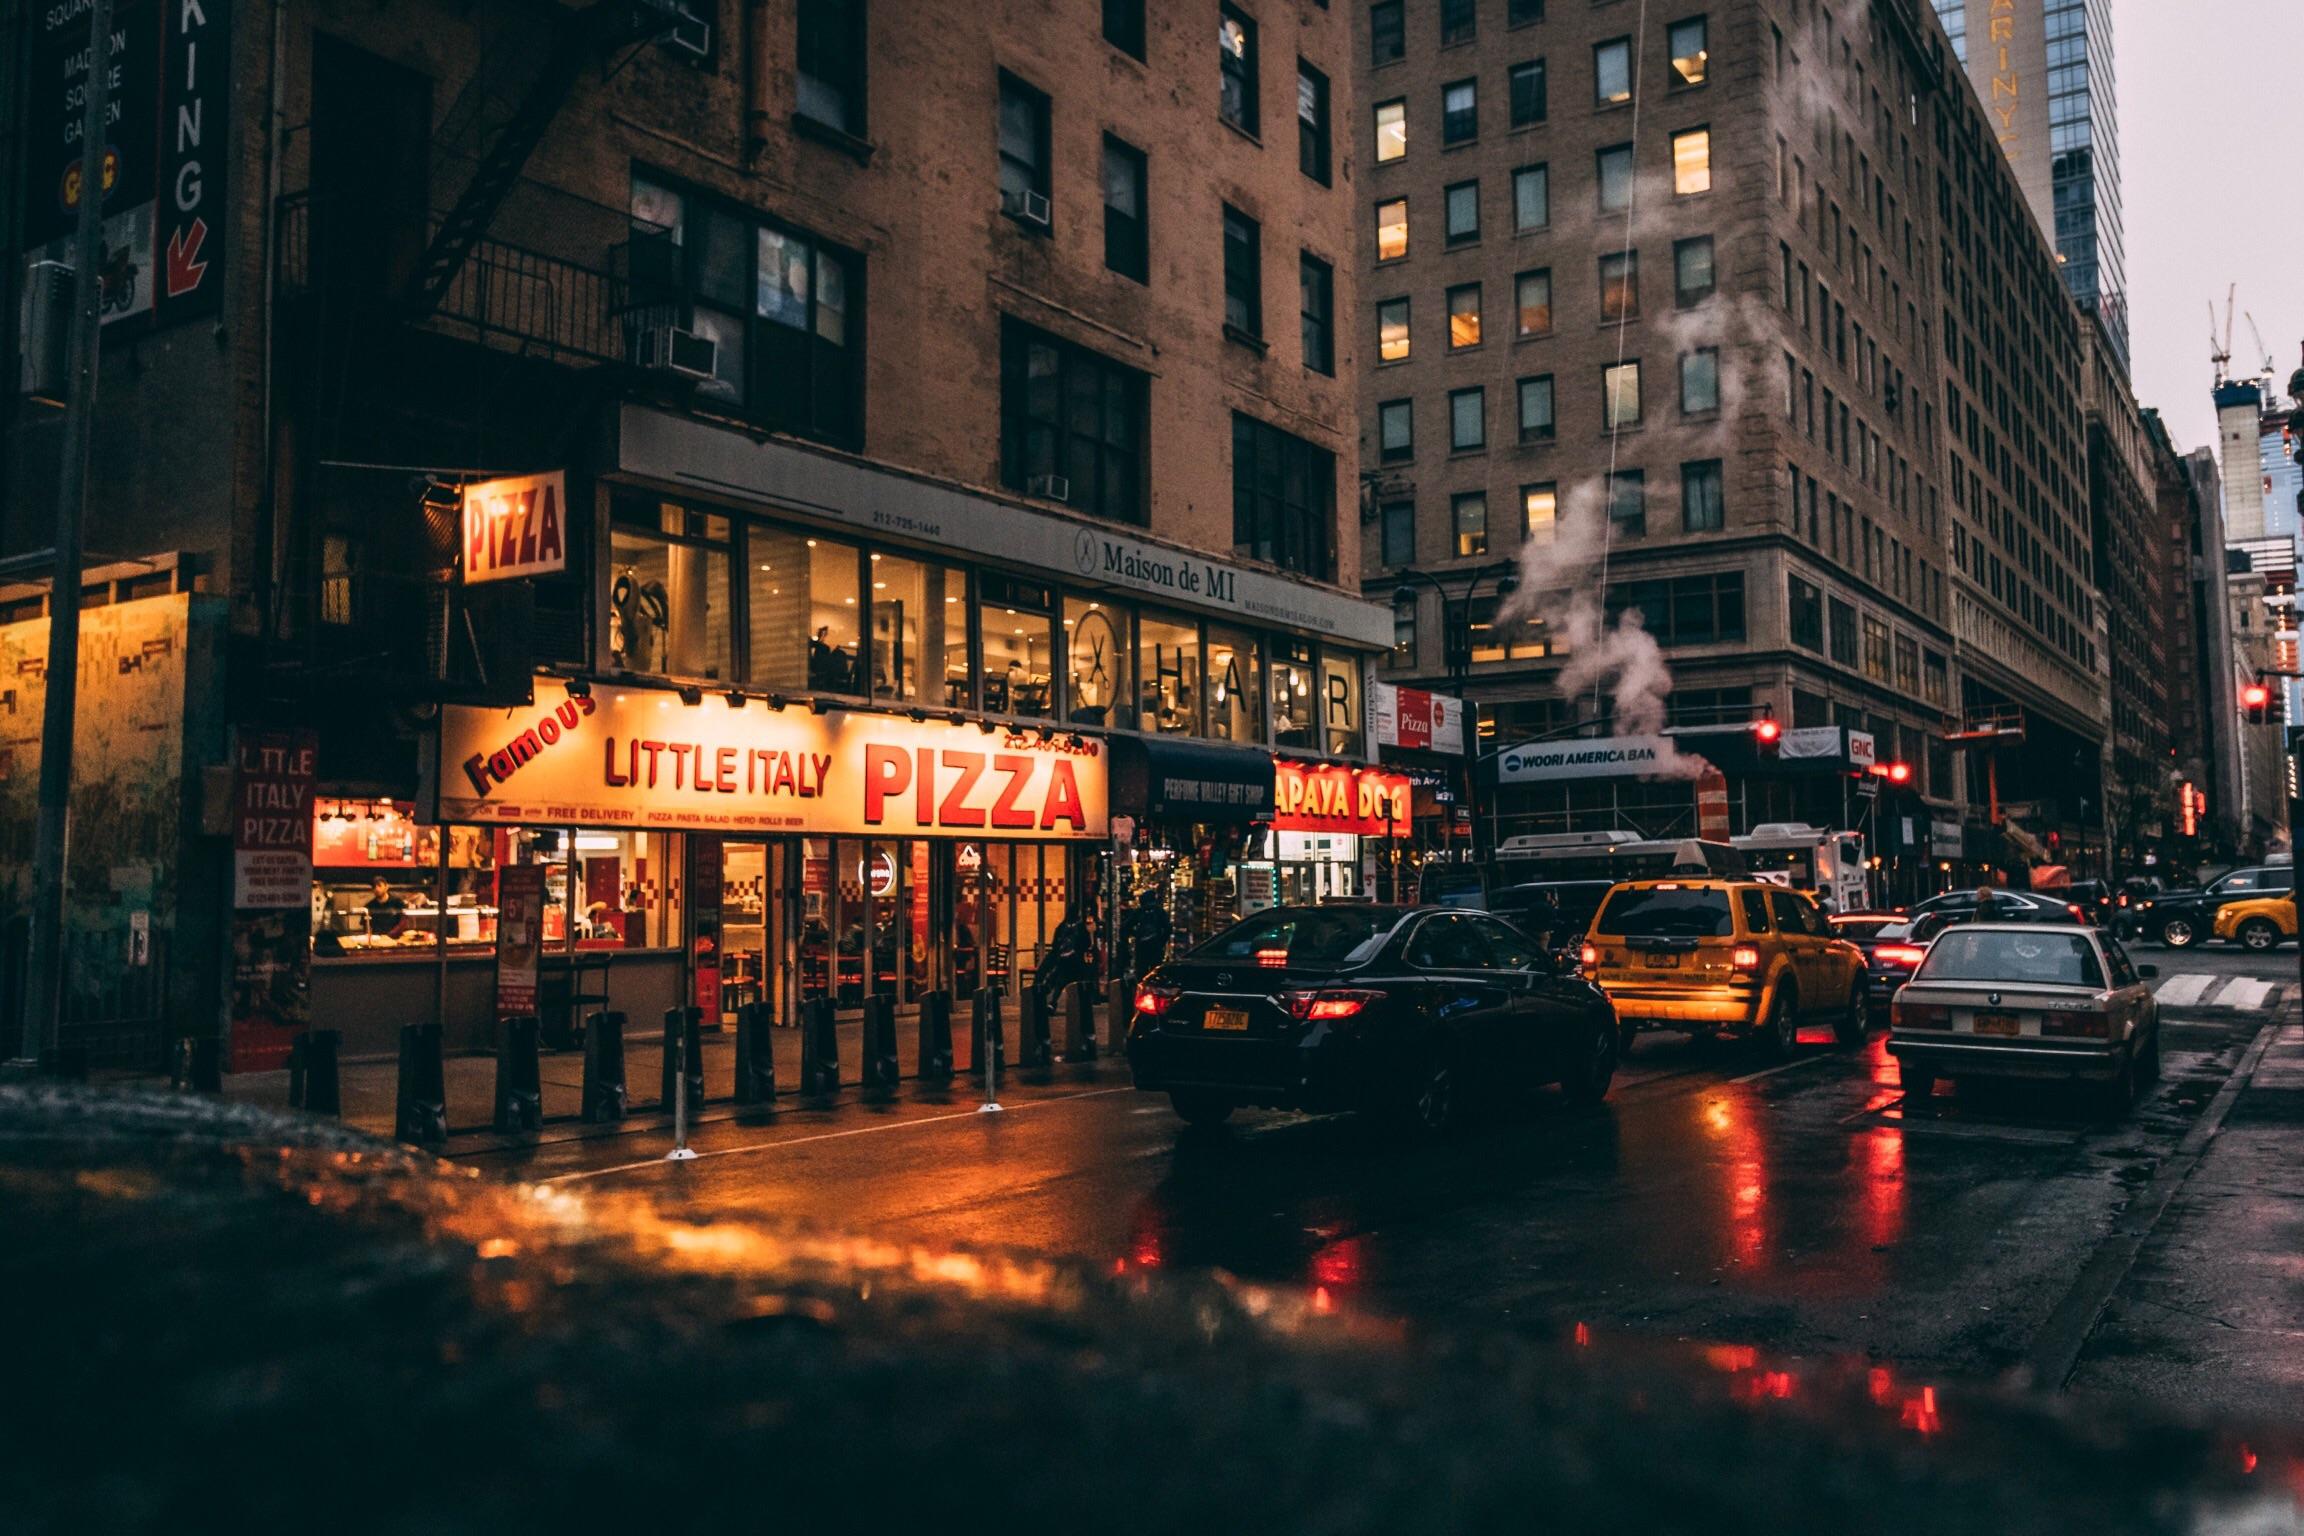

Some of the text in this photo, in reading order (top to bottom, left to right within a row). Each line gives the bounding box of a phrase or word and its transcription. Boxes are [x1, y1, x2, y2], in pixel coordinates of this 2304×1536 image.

[64, 28, 126, 80] MADON
[65, 64, 122, 111] SQE
[64, 99, 121, 145] GAEN
[469, 484, 562, 572] PIZZA
[1103, 541, 1174, 587] Maison
[1178, 561, 1200, 593] de
[1205, 566, 1235, 602] MI
[1401, 712, 1429, 733] Pizza
[241, 746, 313, 776] LTTLE
[463, 697, 597, 798] Famous
[1522, 748, 1656, 768] WOORI AMERICA BAN
[1851, 738, 1872, 757] GNC
[606, 737, 832, 798] LITTLE ITALY
[864, 743, 1087, 831] PIZZA
[246, 782, 306, 810] ITALY
[547, 806, 577, 818] FREE
[581, 807, 635, 820] DELIVERY
[1358, 782, 1403, 821] DOG
[243, 818, 307, 844] PIZZA
[648, 811, 673, 821] PIZZA
[676, 813, 700, 822] PASTA
[704, 815, 730, 824] SALAD
[733, 816, 756, 825] HERO
